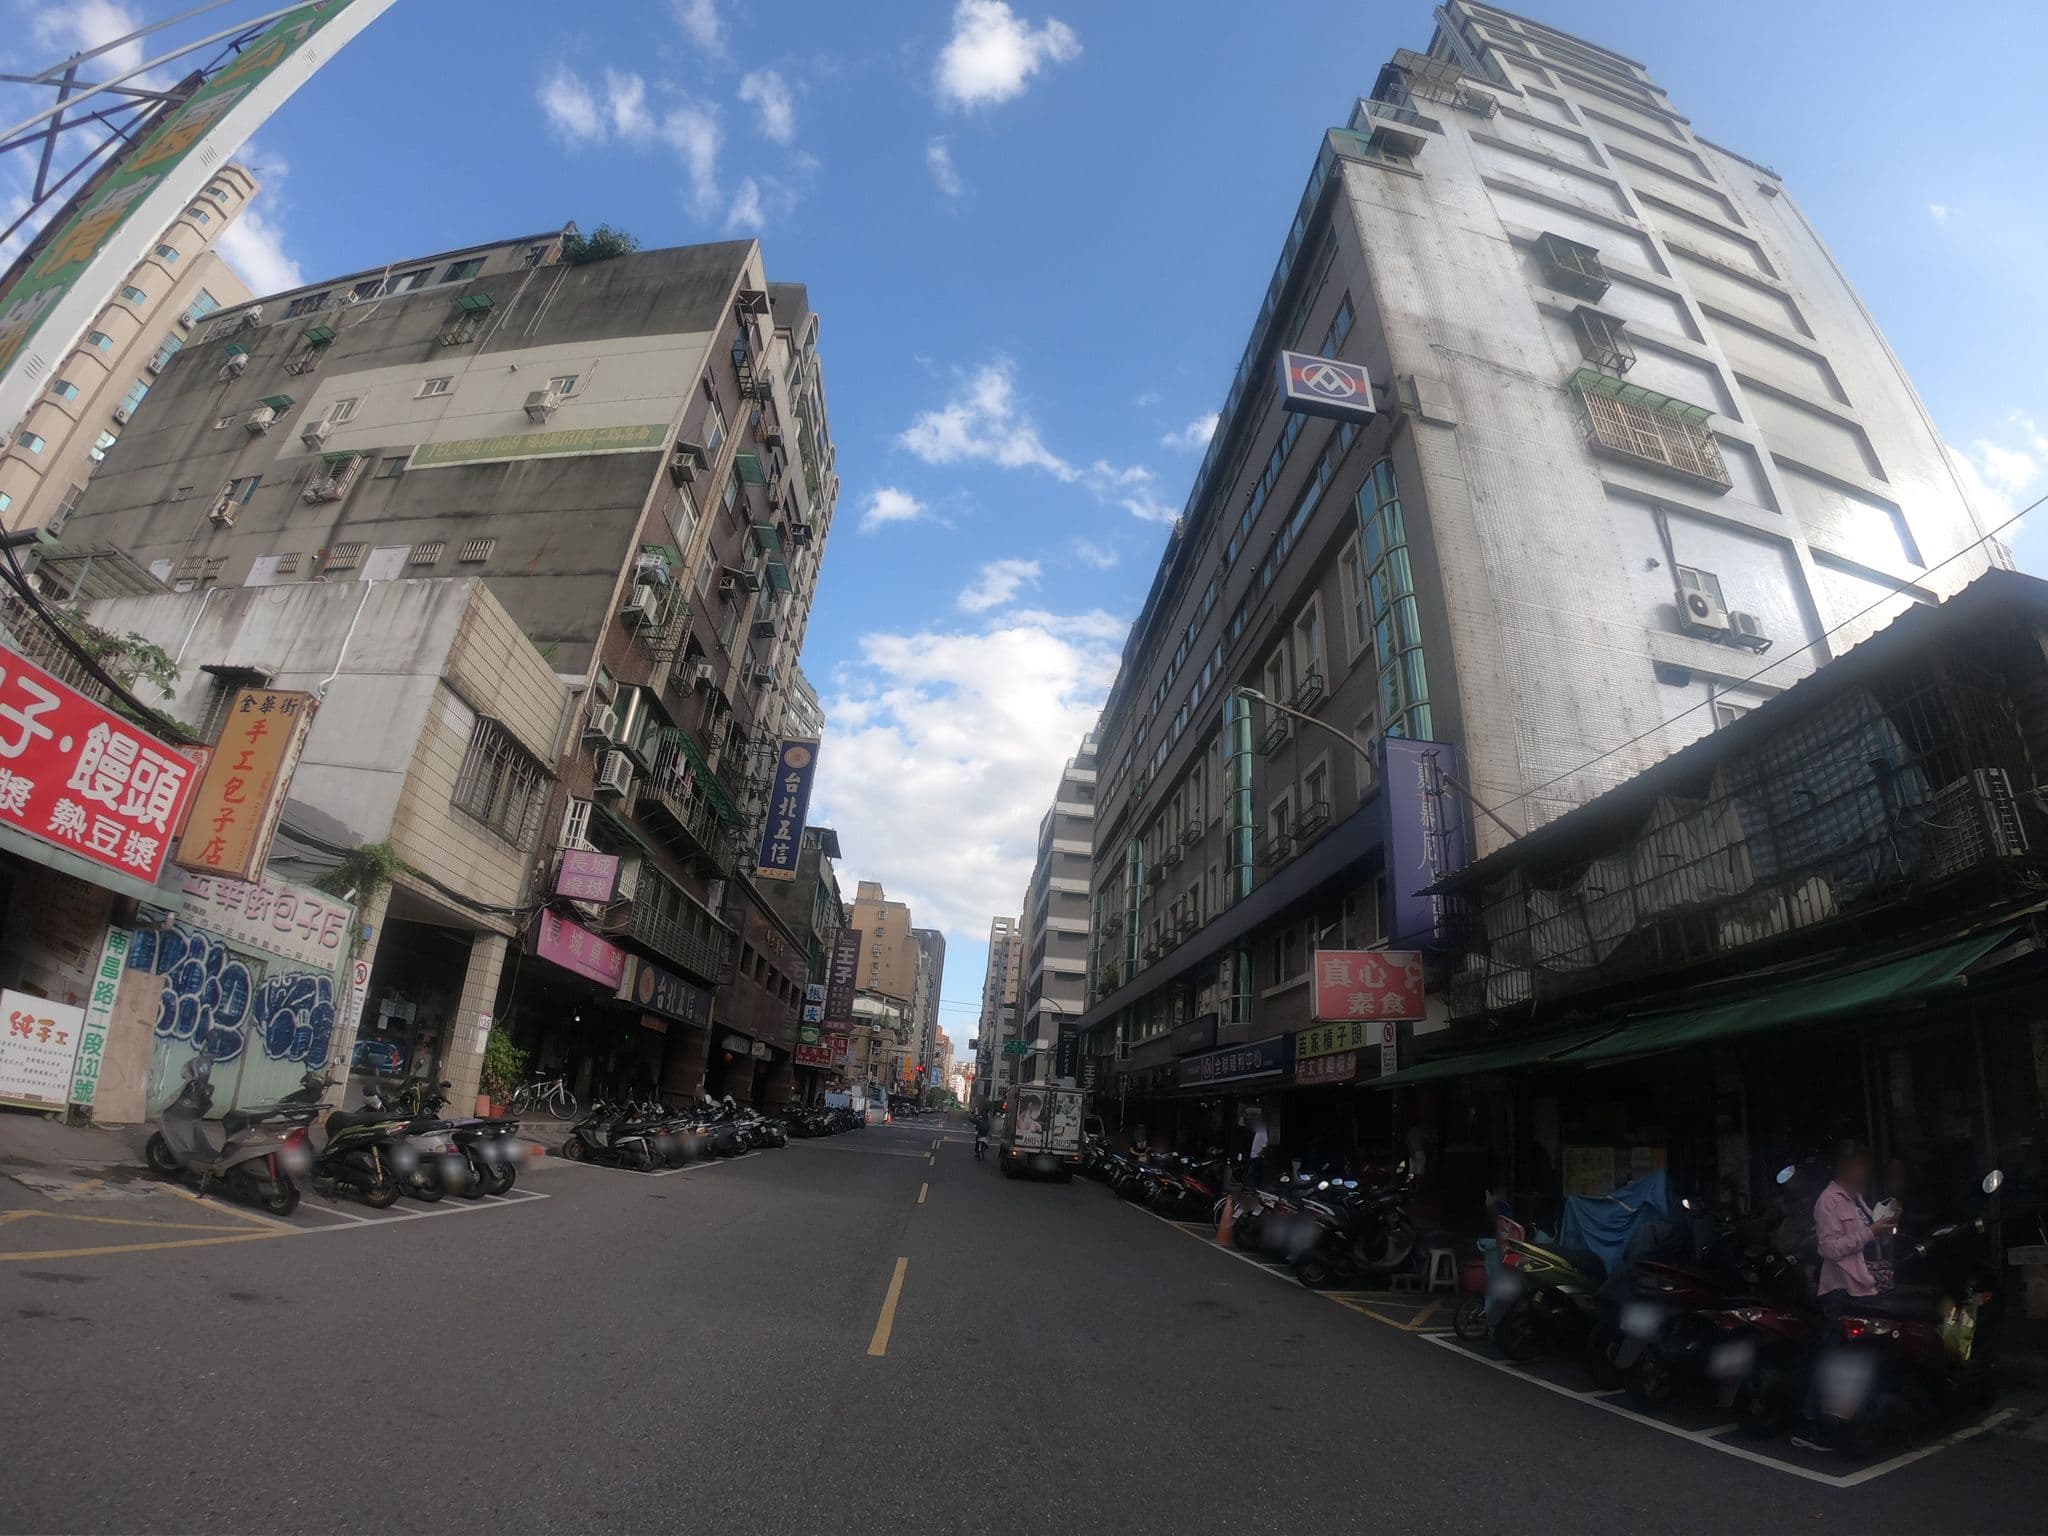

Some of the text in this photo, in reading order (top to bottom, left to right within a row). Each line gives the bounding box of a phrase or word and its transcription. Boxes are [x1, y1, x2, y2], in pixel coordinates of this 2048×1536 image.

[238, 695, 300, 717] 金華街
[198, 719, 269, 865] 手工包子店
[47, 797, 159, 872] 熱豆漿
[772, 772, 801, 865] 台北五信
[570, 852, 611, 875] 長城
[566, 878, 604, 899] 桌球
[72, 930, 128, 1103] 南昌路二段131號
[657, 976, 696, 1019] 台北五信
[1348, 992, 1406, 1015] 素食
[9, 1010, 69, 1046] 純手工
